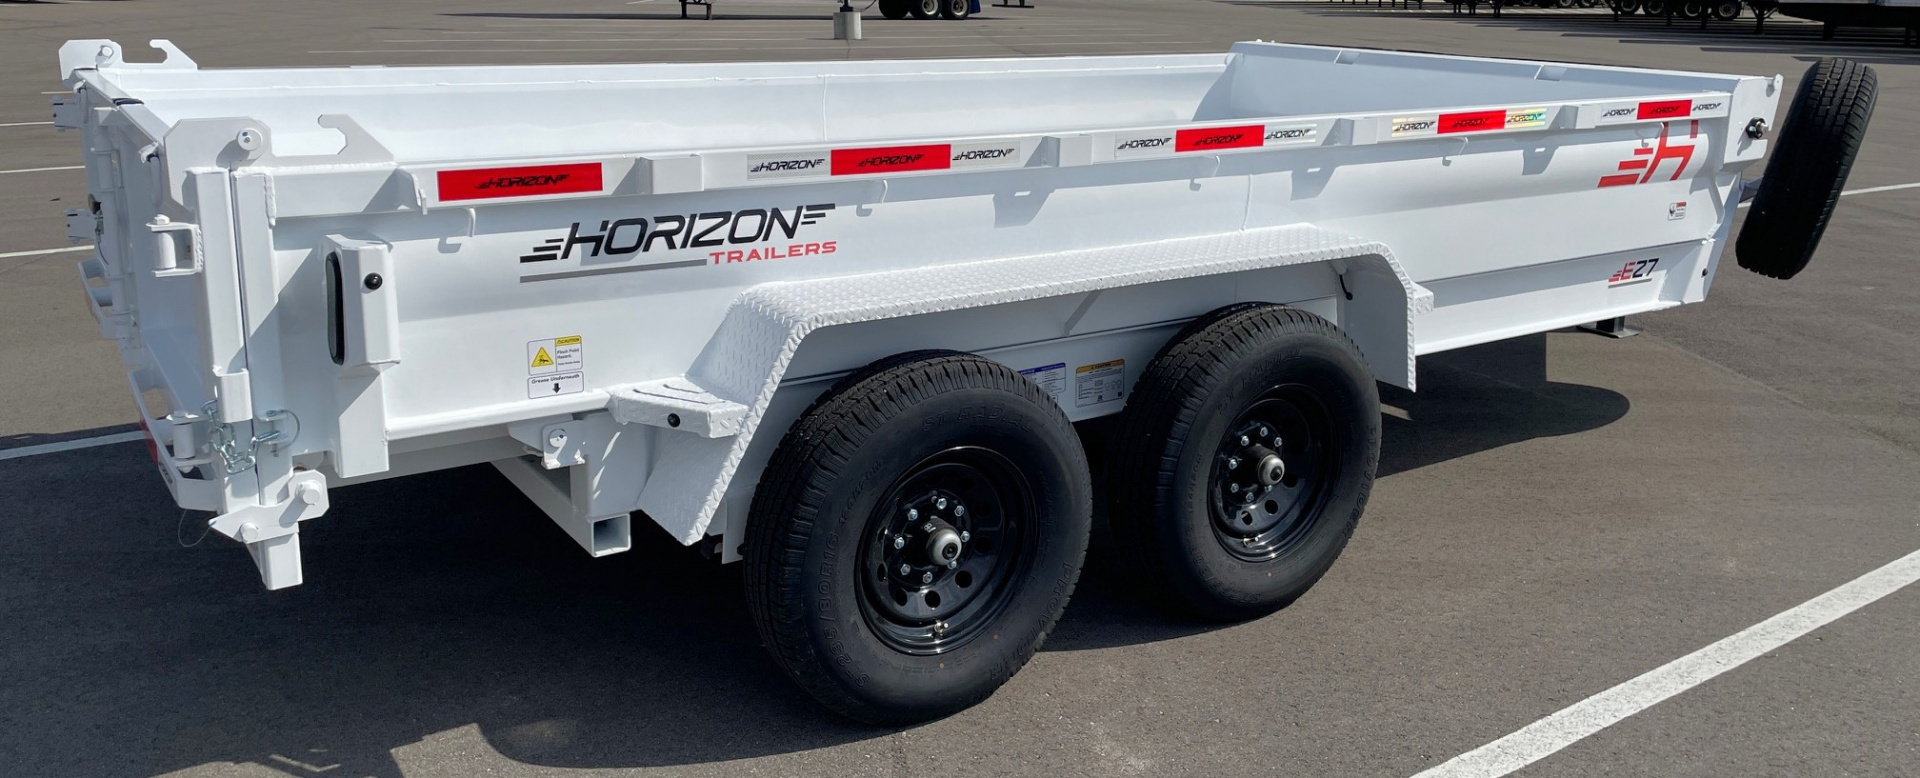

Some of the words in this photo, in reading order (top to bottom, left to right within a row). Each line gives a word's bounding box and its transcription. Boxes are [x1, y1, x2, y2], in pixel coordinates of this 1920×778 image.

[1509, 113, 1539, 123] HORIZON
[1398, 121, 1431, 131] HORIZON
[1198, 134, 1240, 146] HORIZON
[1269, 129, 1309, 140] HORIZON
[1123, 138, 1167, 149] HORIZON
[958, 149, 1010, 160] HORIZON
[759, 158, 818, 172] HORIZON
[861, 154, 920, 167] HORIZON
[486, 175, 559, 189] HORIZON
[560, 205, 804, 260] HORIZON
[709, 241, 837, 265] TRAILERS
[551, 374, 580, 382] Underneath
